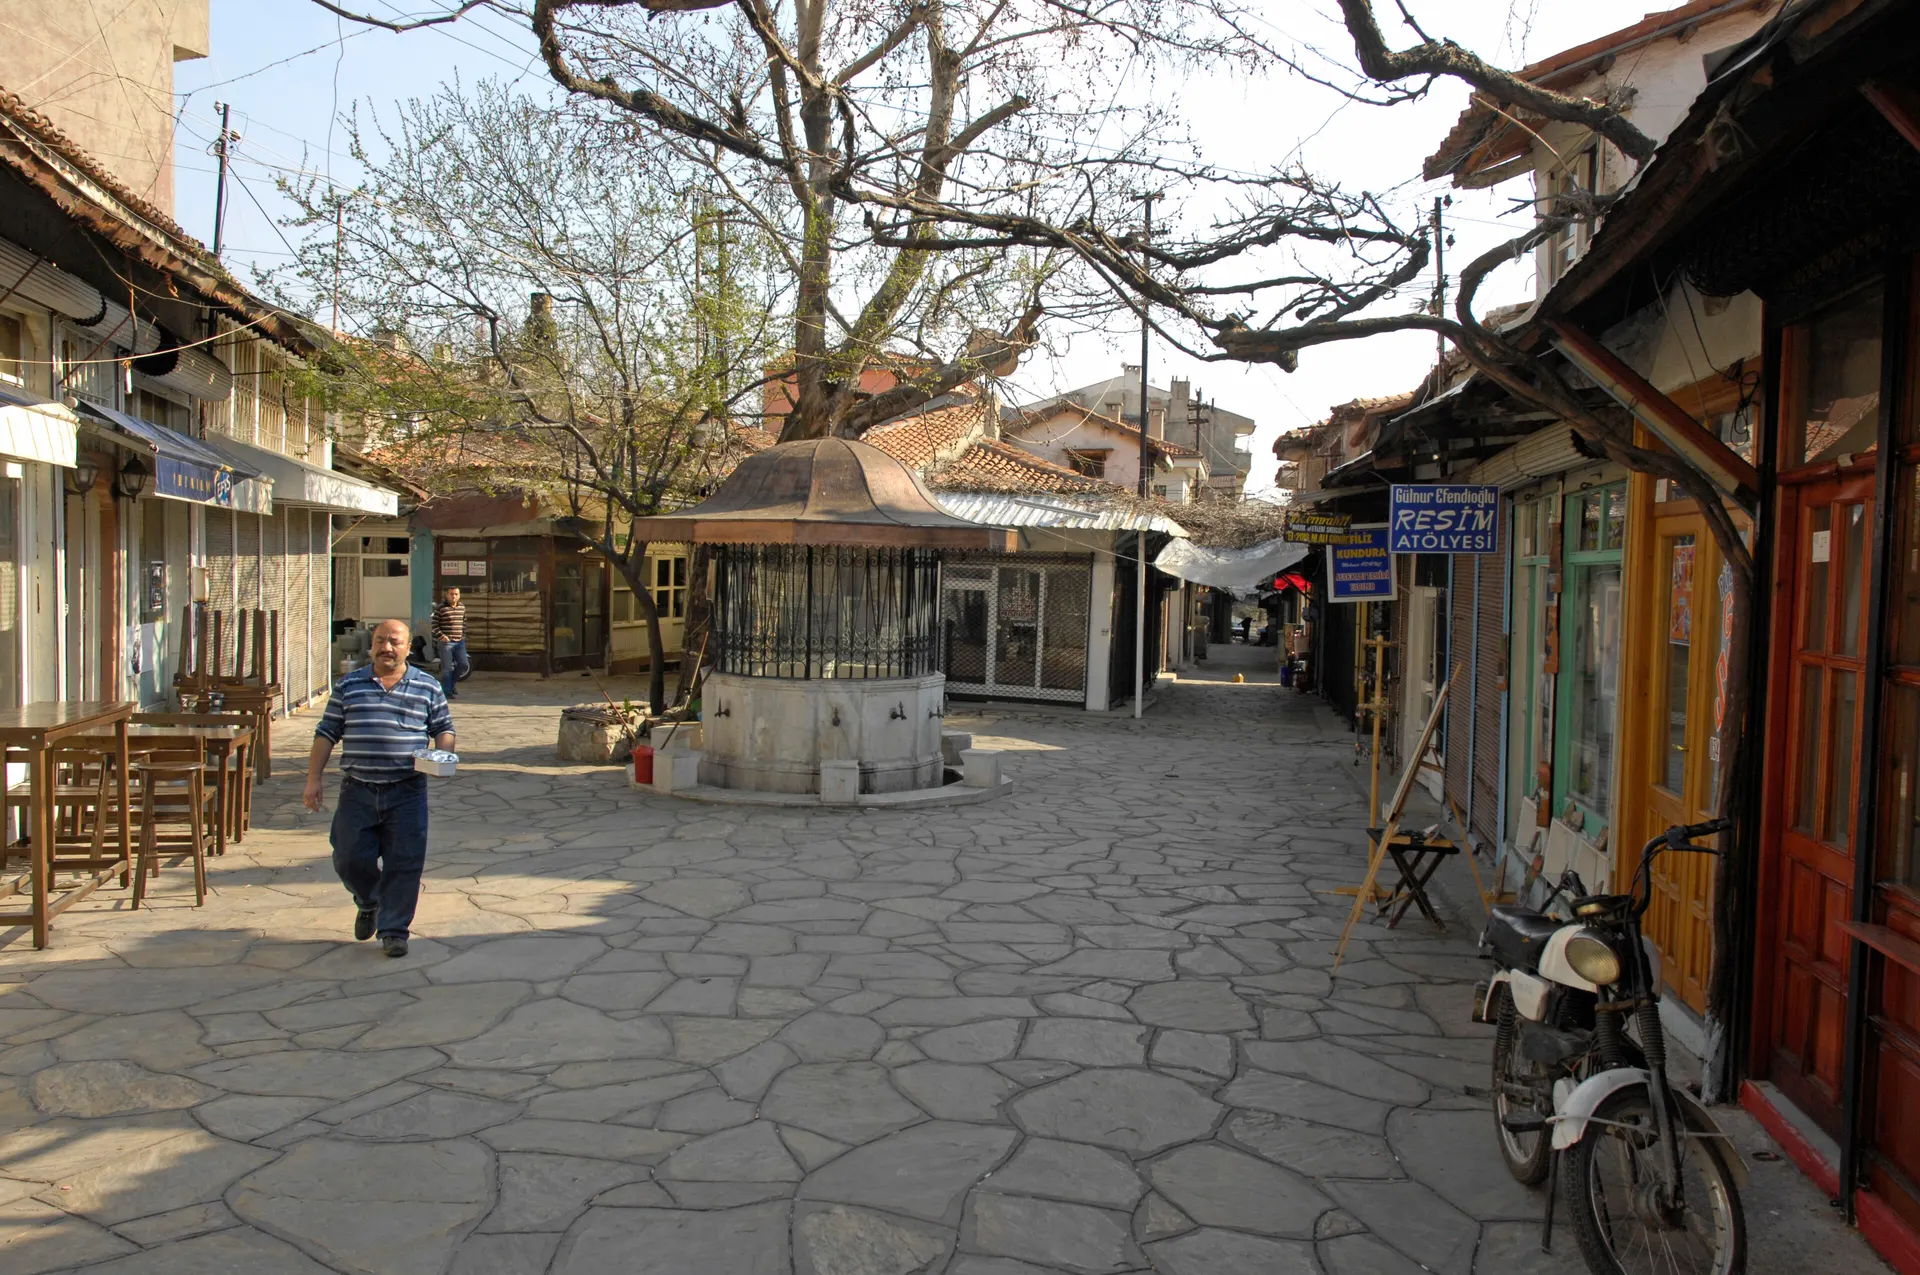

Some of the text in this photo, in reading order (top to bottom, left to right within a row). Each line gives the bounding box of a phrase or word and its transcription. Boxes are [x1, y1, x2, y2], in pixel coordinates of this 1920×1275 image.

[1396, 488, 1495, 508] Gülnur Efendioğlu
[1395, 506, 1495, 531] RESİM
[1397, 532, 1492, 549] ATÖLYESİ
[1337, 548, 1387, 558] KUNDURA
